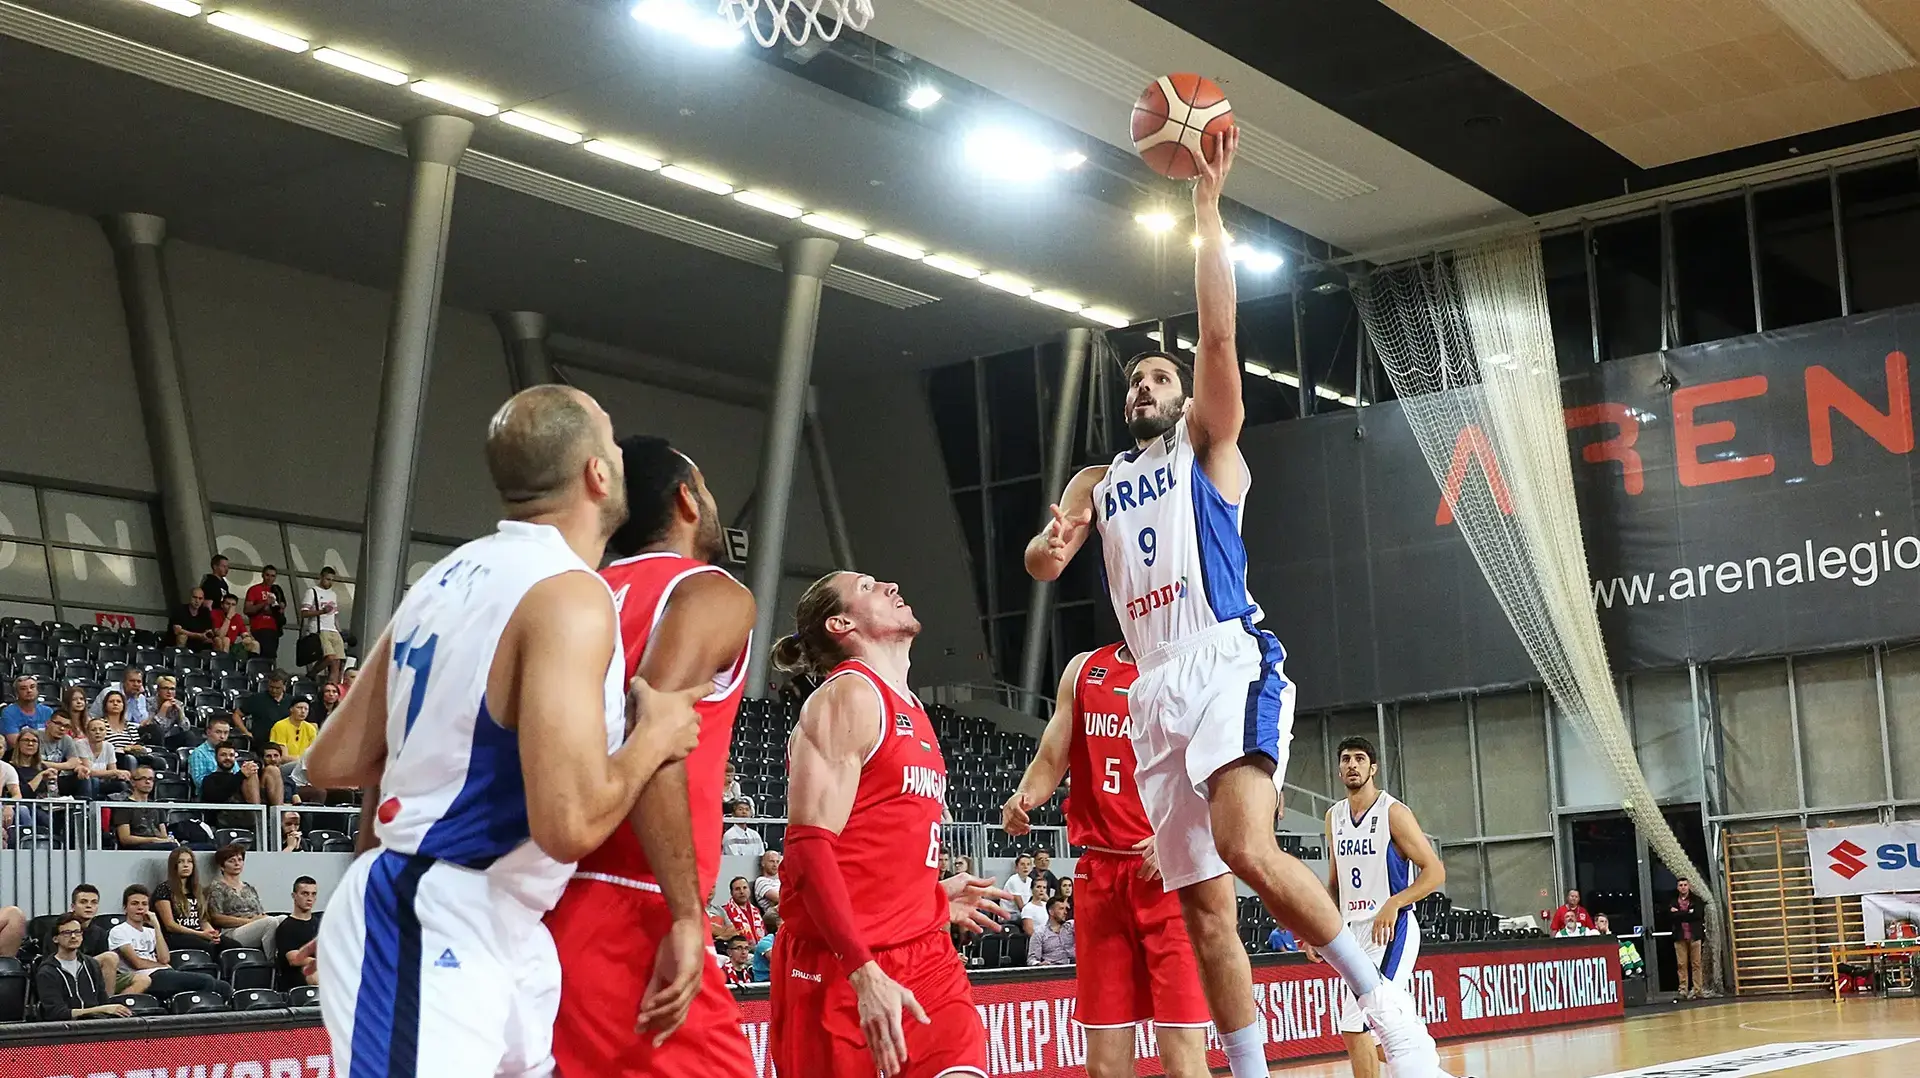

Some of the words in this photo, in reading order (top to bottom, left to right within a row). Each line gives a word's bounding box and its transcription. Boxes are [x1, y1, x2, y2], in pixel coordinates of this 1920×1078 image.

[726, 530, 748, 560] E
[1138, 527, 1157, 567] 9
[1593, 529, 1920, 609] ww.arenalegio
[1084, 712, 1132, 739] UNGA
[1102, 757, 1121, 794] 5
[1337, 838, 1376, 856] ISRAEL
[1351, 867, 1362, 889] 8
[1483, 963, 1526, 1017] SKLEP
[1269, 978, 1326, 1042] SKLEP
